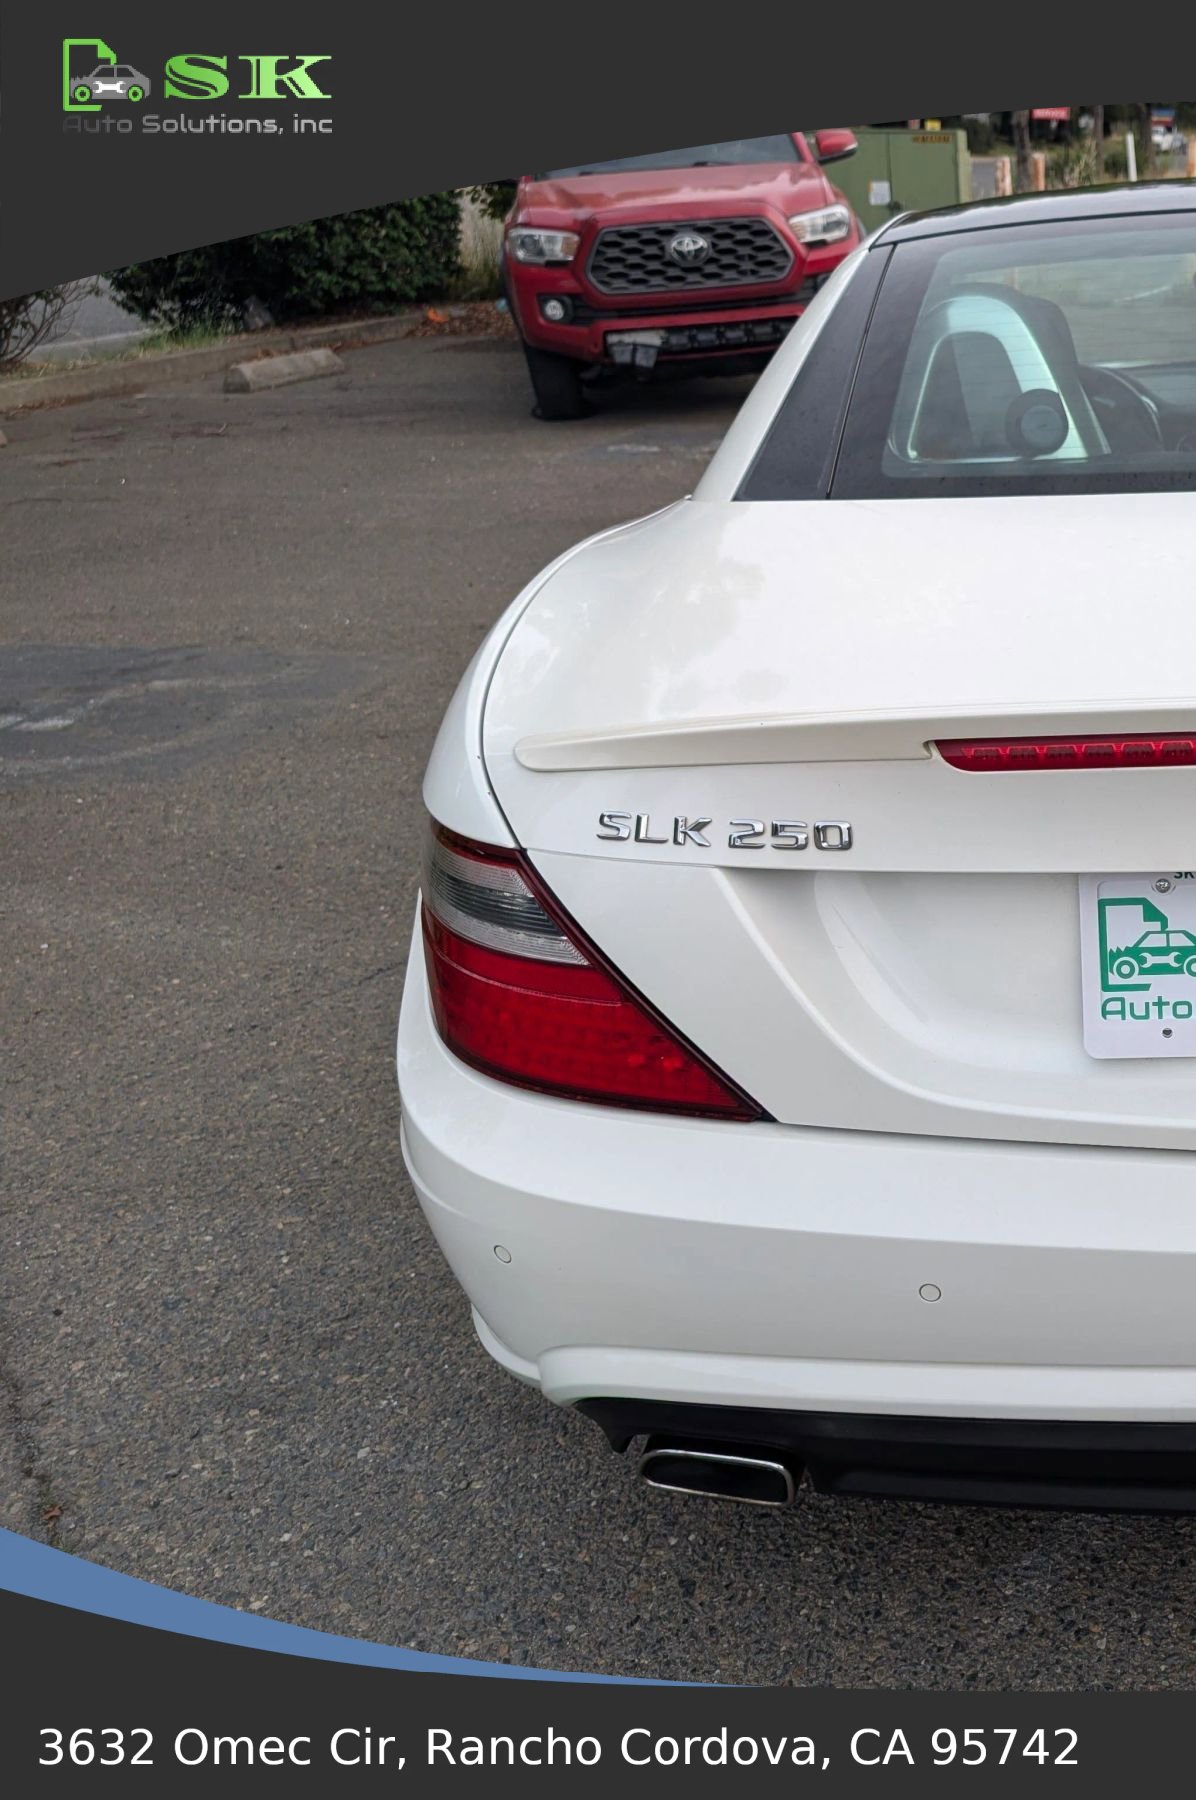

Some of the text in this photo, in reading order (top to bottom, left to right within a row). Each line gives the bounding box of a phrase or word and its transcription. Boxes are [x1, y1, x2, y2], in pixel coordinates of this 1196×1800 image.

[596, 810, 853, 851] SLK 250
[1101, 995, 1193, 1021] Auto
